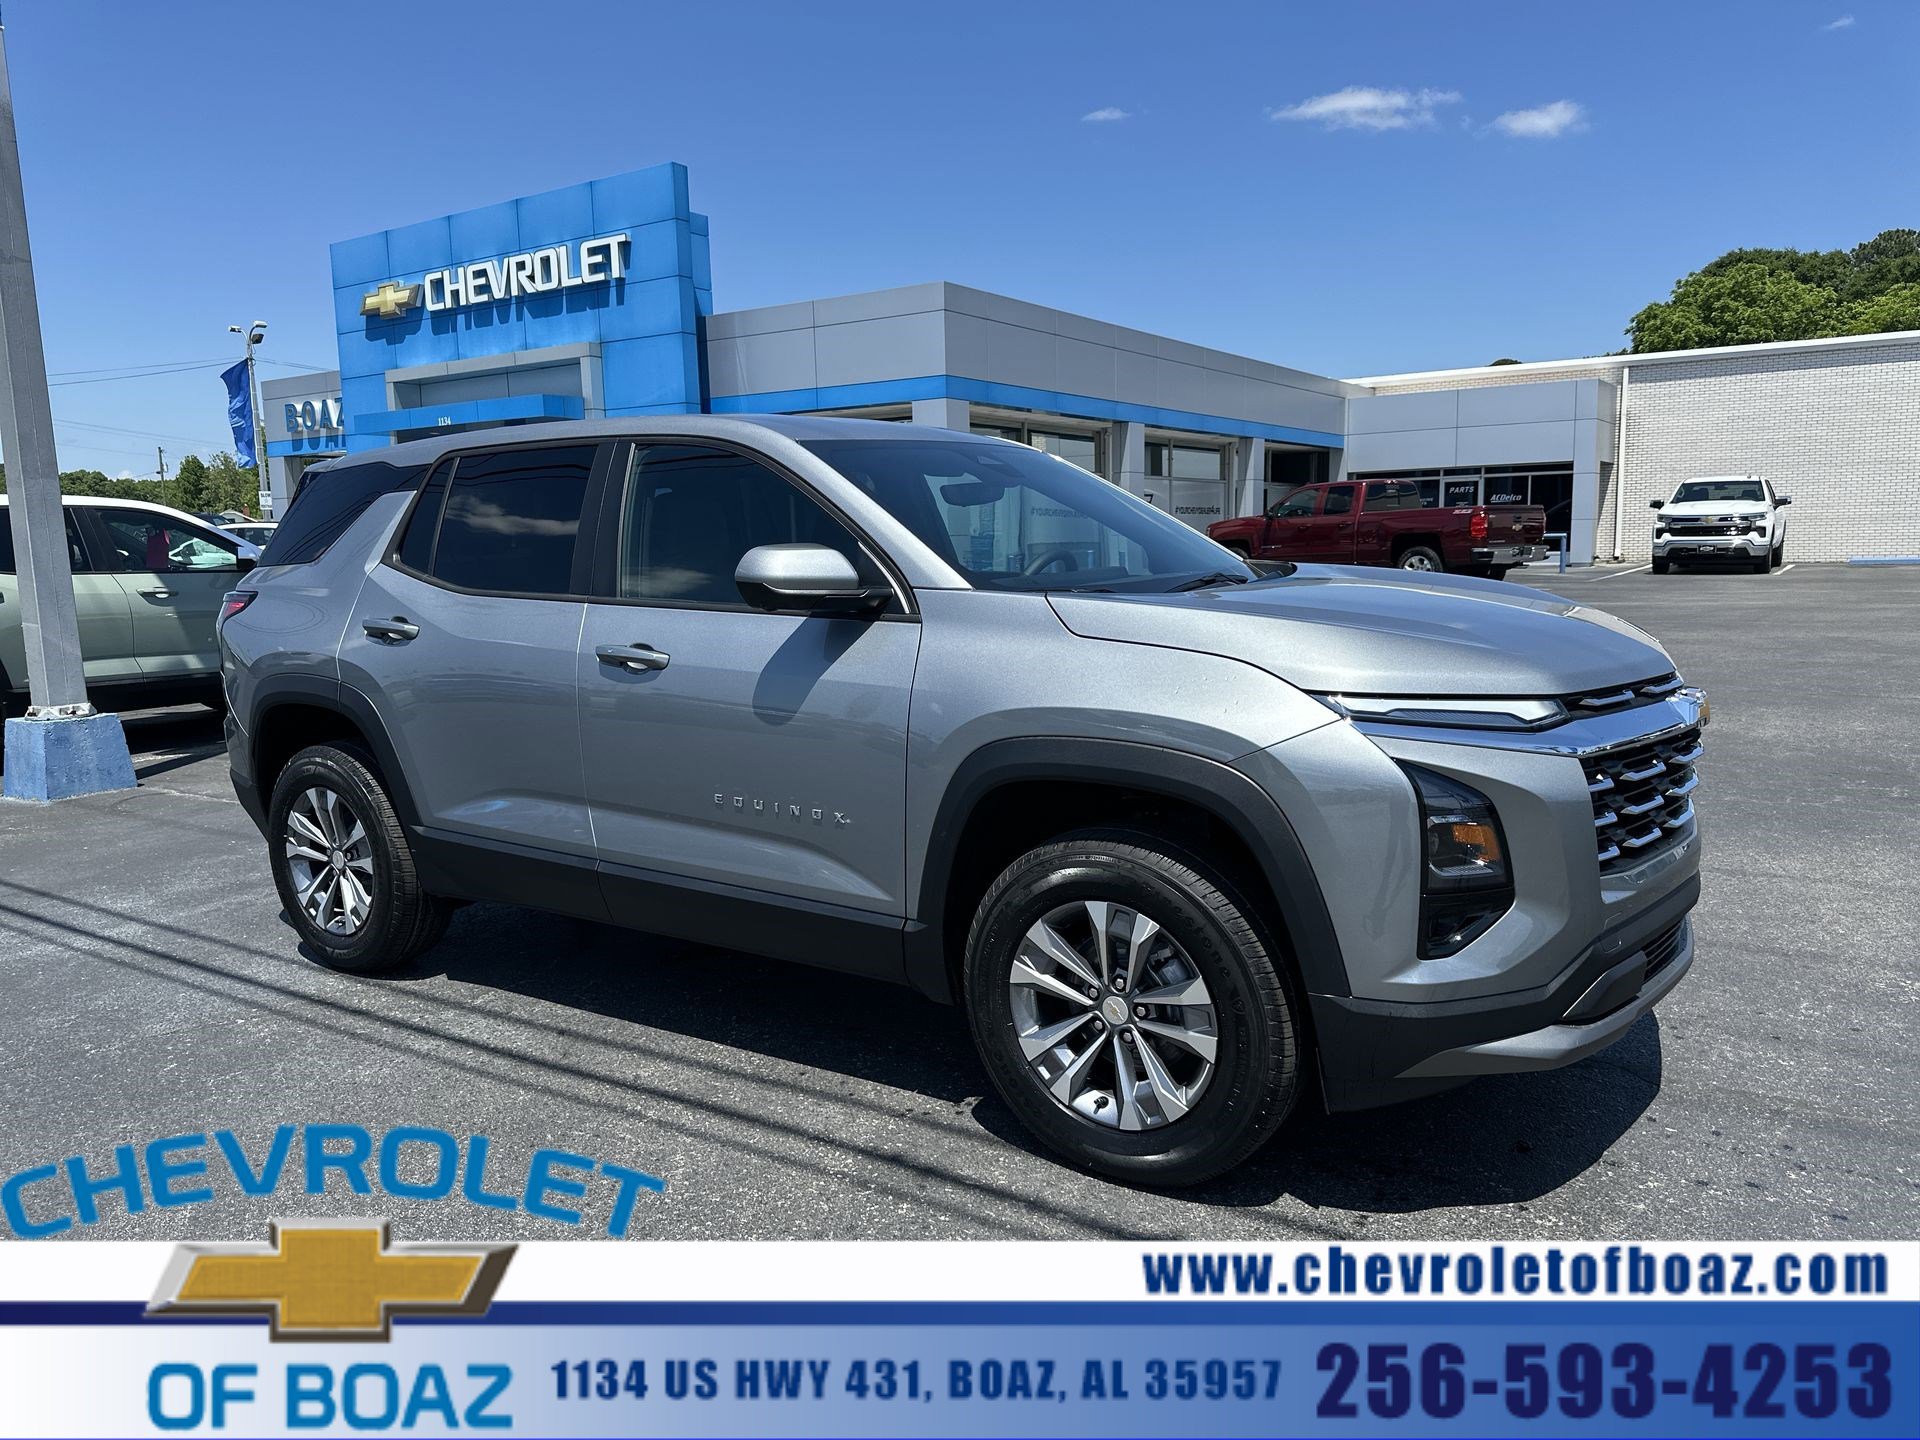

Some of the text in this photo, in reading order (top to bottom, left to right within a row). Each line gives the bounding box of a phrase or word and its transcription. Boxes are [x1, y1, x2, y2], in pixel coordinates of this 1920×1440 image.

[423, 232, 632, 311] CHEVROLET
[438, 416, 451, 426] 1134
[1449, 486, 1475, 494] PARTS
[1490, 493, 1522, 502] ACDelco
[713, 793, 851, 824] EQUINOX
